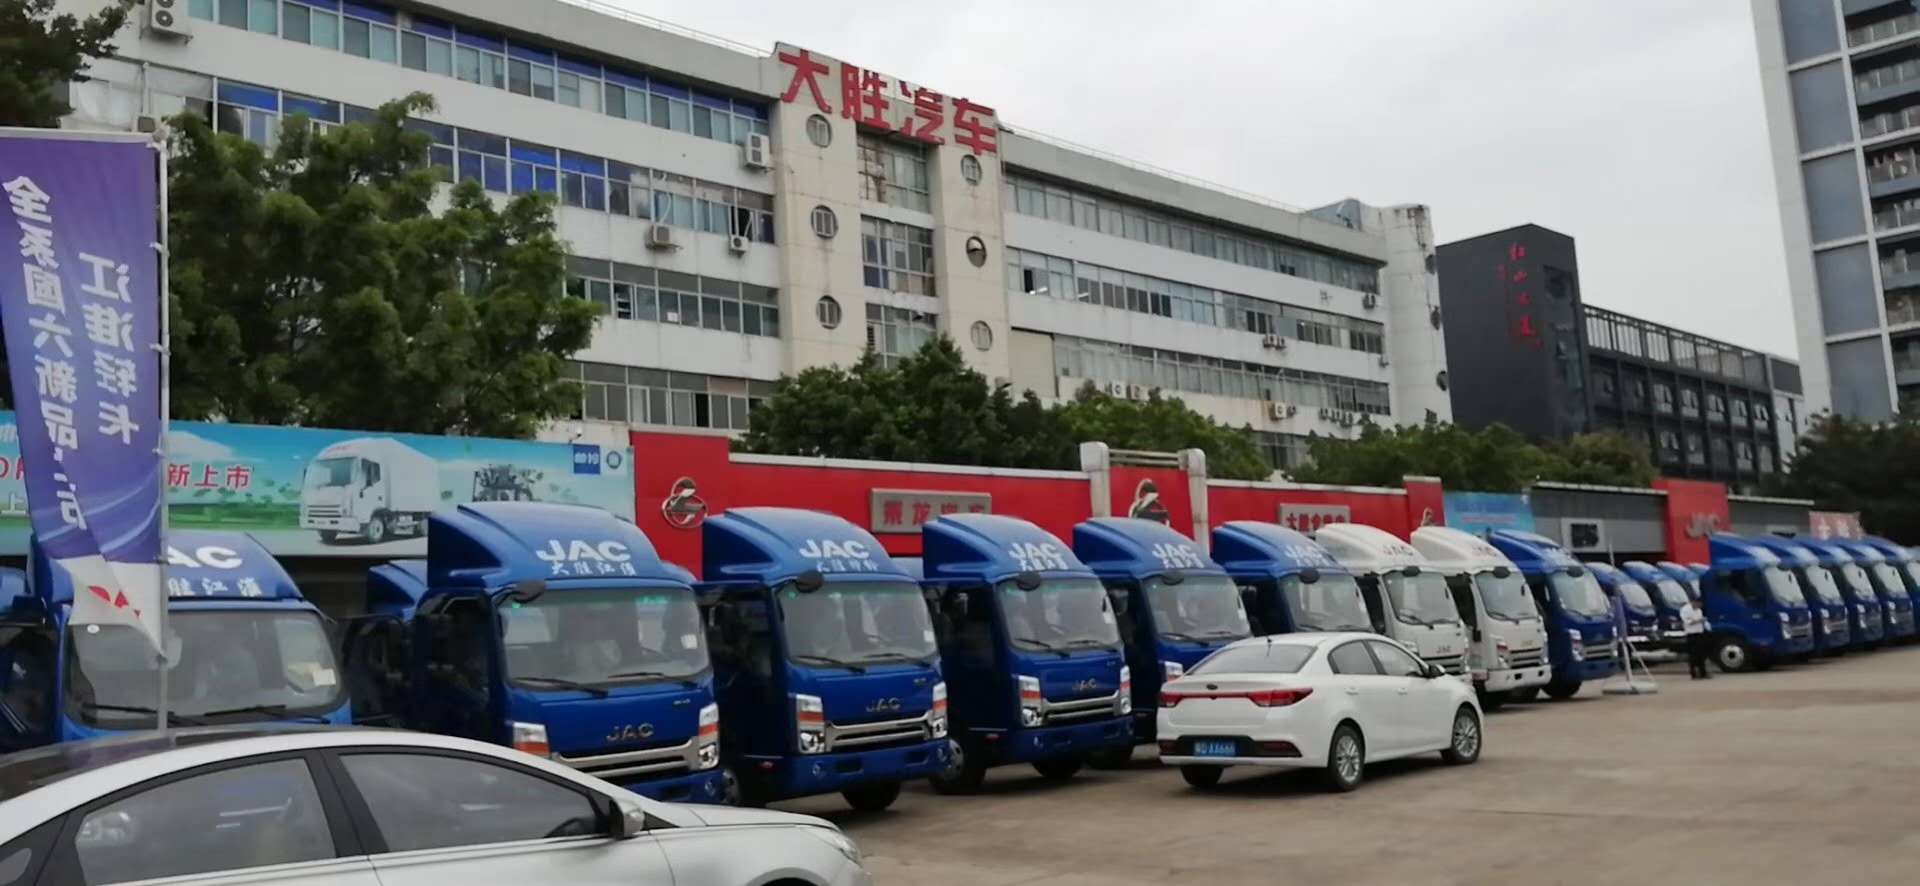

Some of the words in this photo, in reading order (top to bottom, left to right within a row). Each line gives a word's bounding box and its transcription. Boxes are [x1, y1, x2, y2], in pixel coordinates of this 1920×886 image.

[779, 49, 998, 155] 大胜汽车
[167, 545, 243, 570] AC
[535, 539, 632, 562] JAC
[799, 539, 870, 559] JAC
[1008, 542, 1061, 562] JAC
[1151, 543, 1198, 562] JAC
[167, 576, 262, 597] 胜江淮
[865, 697, 901, 713] JAC
[606, 722, 655, 742] JAC
